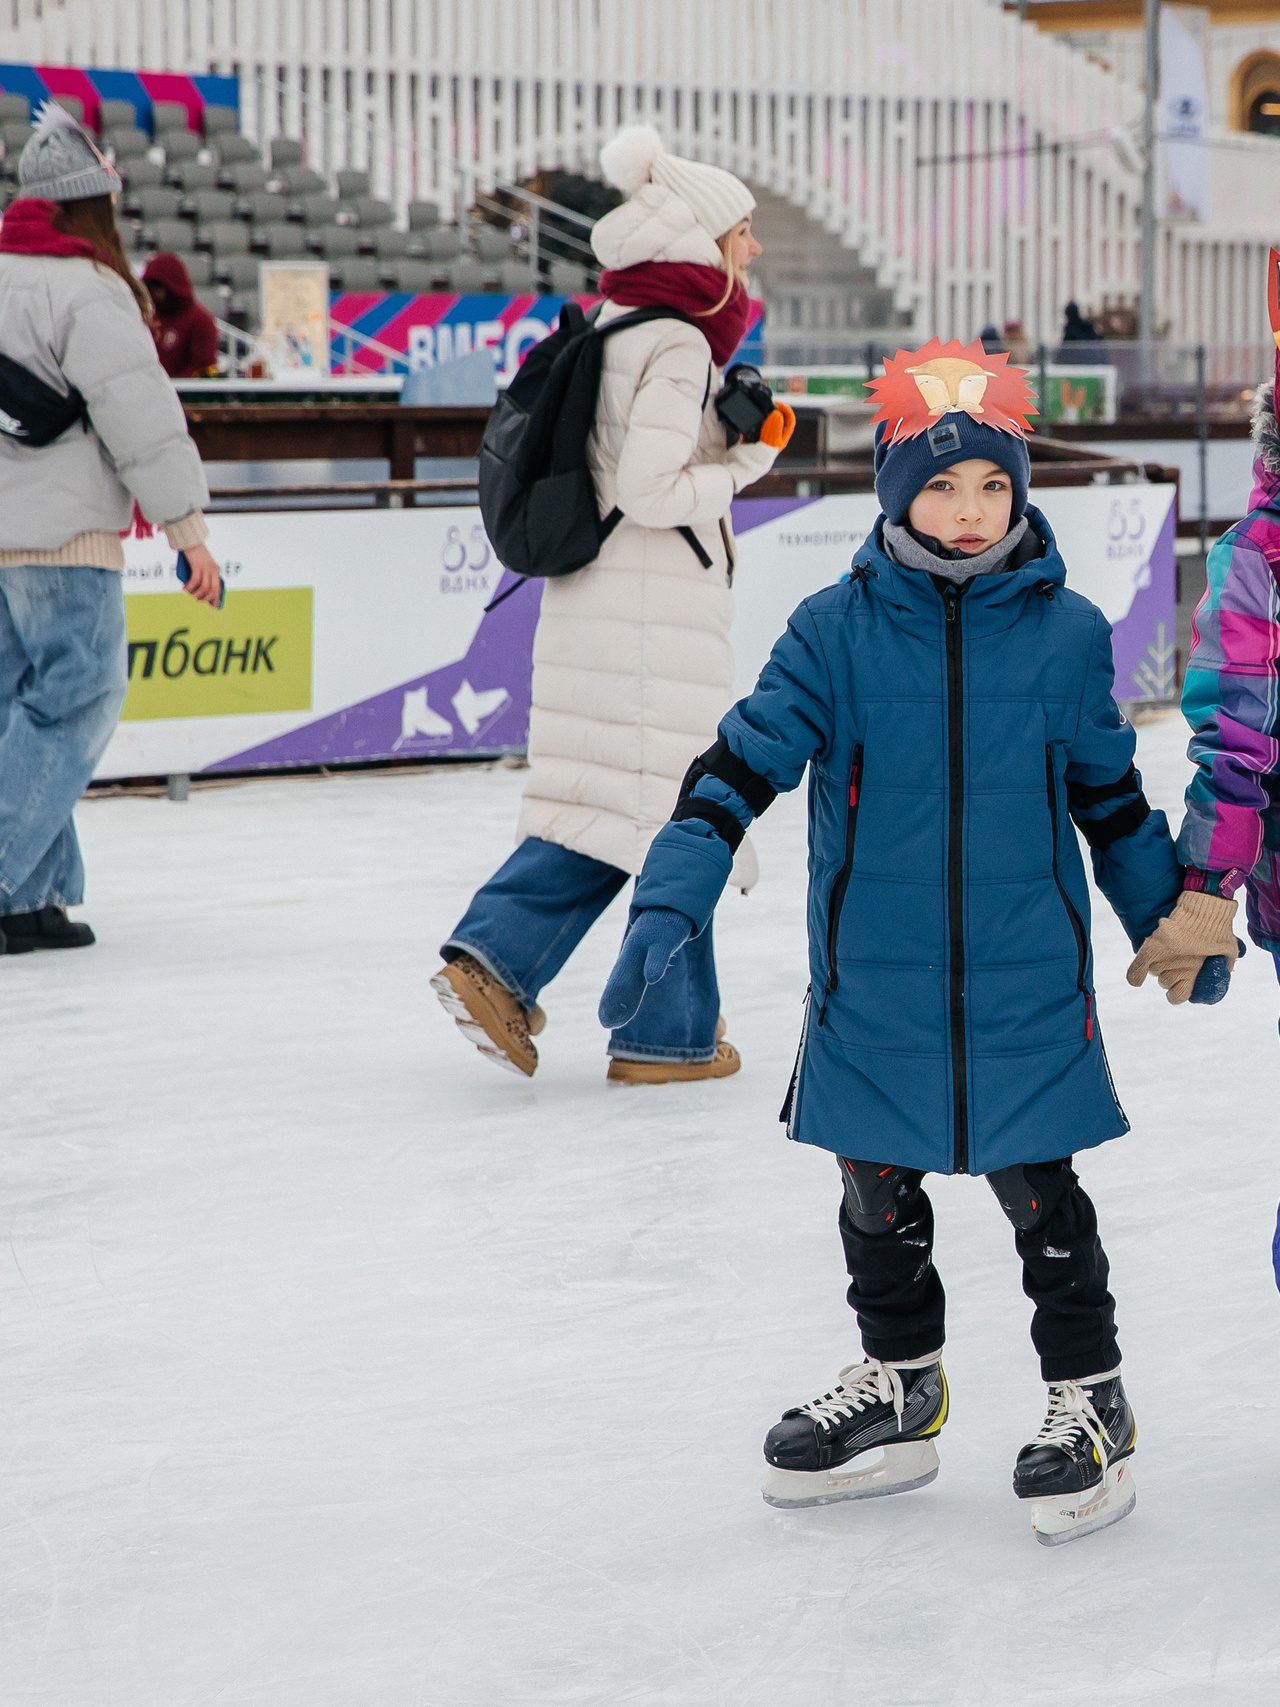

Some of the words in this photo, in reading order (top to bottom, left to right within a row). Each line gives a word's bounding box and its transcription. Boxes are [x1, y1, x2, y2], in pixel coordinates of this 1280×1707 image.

[408, 317, 560, 376] ВМЕС
[779, 530, 868, 546] ТЕХНОЛОГИЧ
[127, 627, 279, 680] пбанк
